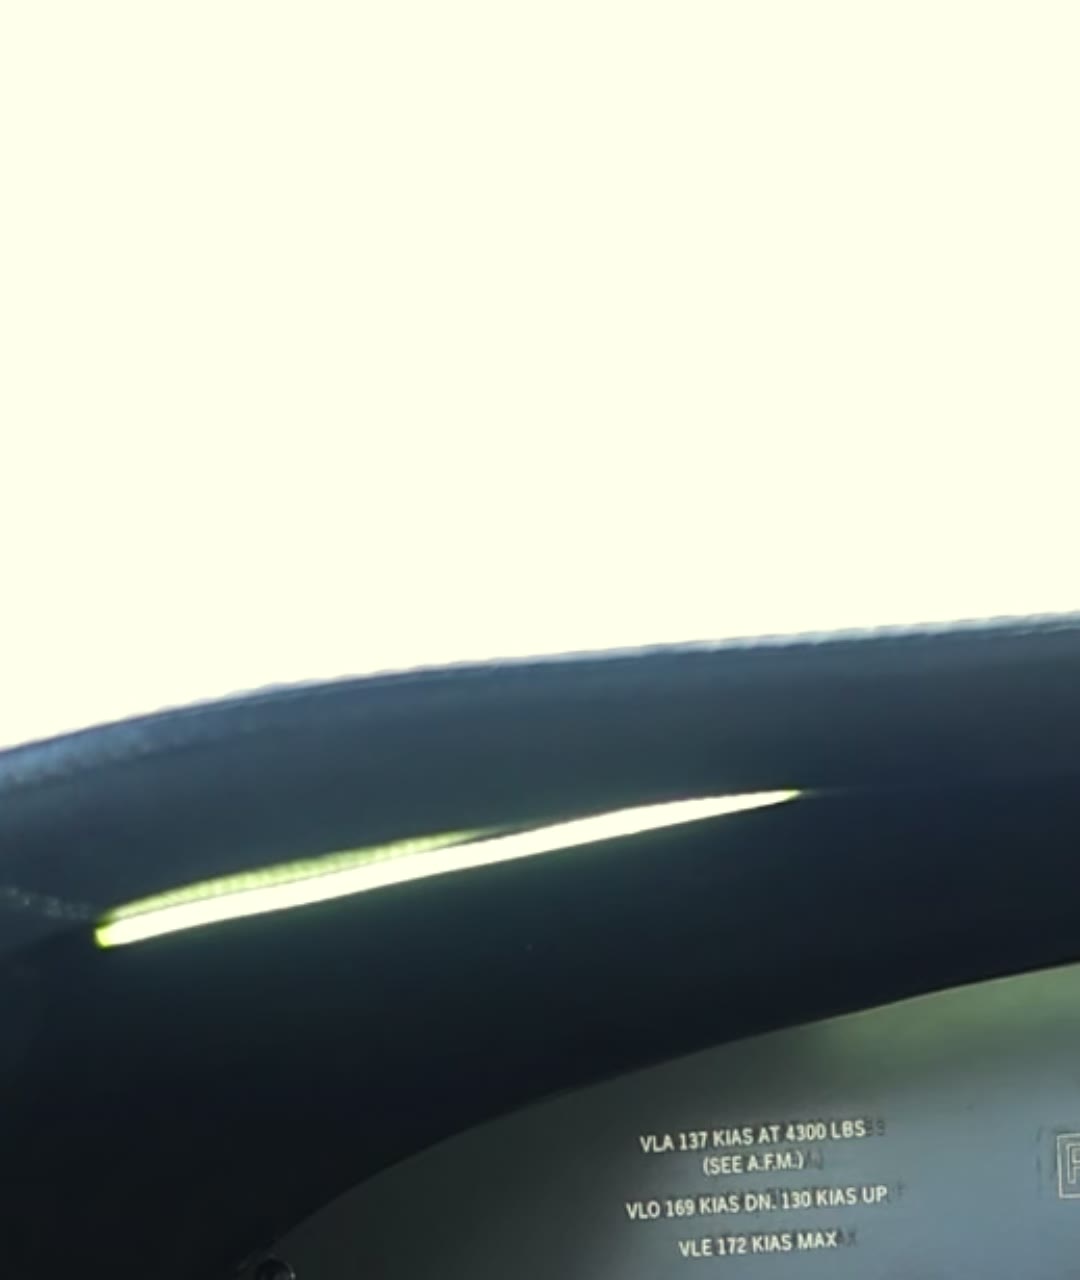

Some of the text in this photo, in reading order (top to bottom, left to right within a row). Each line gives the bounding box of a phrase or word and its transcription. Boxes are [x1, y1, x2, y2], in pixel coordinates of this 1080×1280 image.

[640, 1119, 865, 1152] VLA 137 KIAS AT 4300 LBS
[703, 1155, 742, 1175] (SEE
[626, 1202, 660, 1219] VLO
[666, 1200, 694, 1217] 169
[700, 1196, 739, 1214] KIAS
[782, 1192, 811, 1208] 130
[816, 1189, 856, 1206] KIAS
[862, 1185, 887, 1203] UP
[679, 1231, 837, 1257] VLE 172 KIAS MAX
